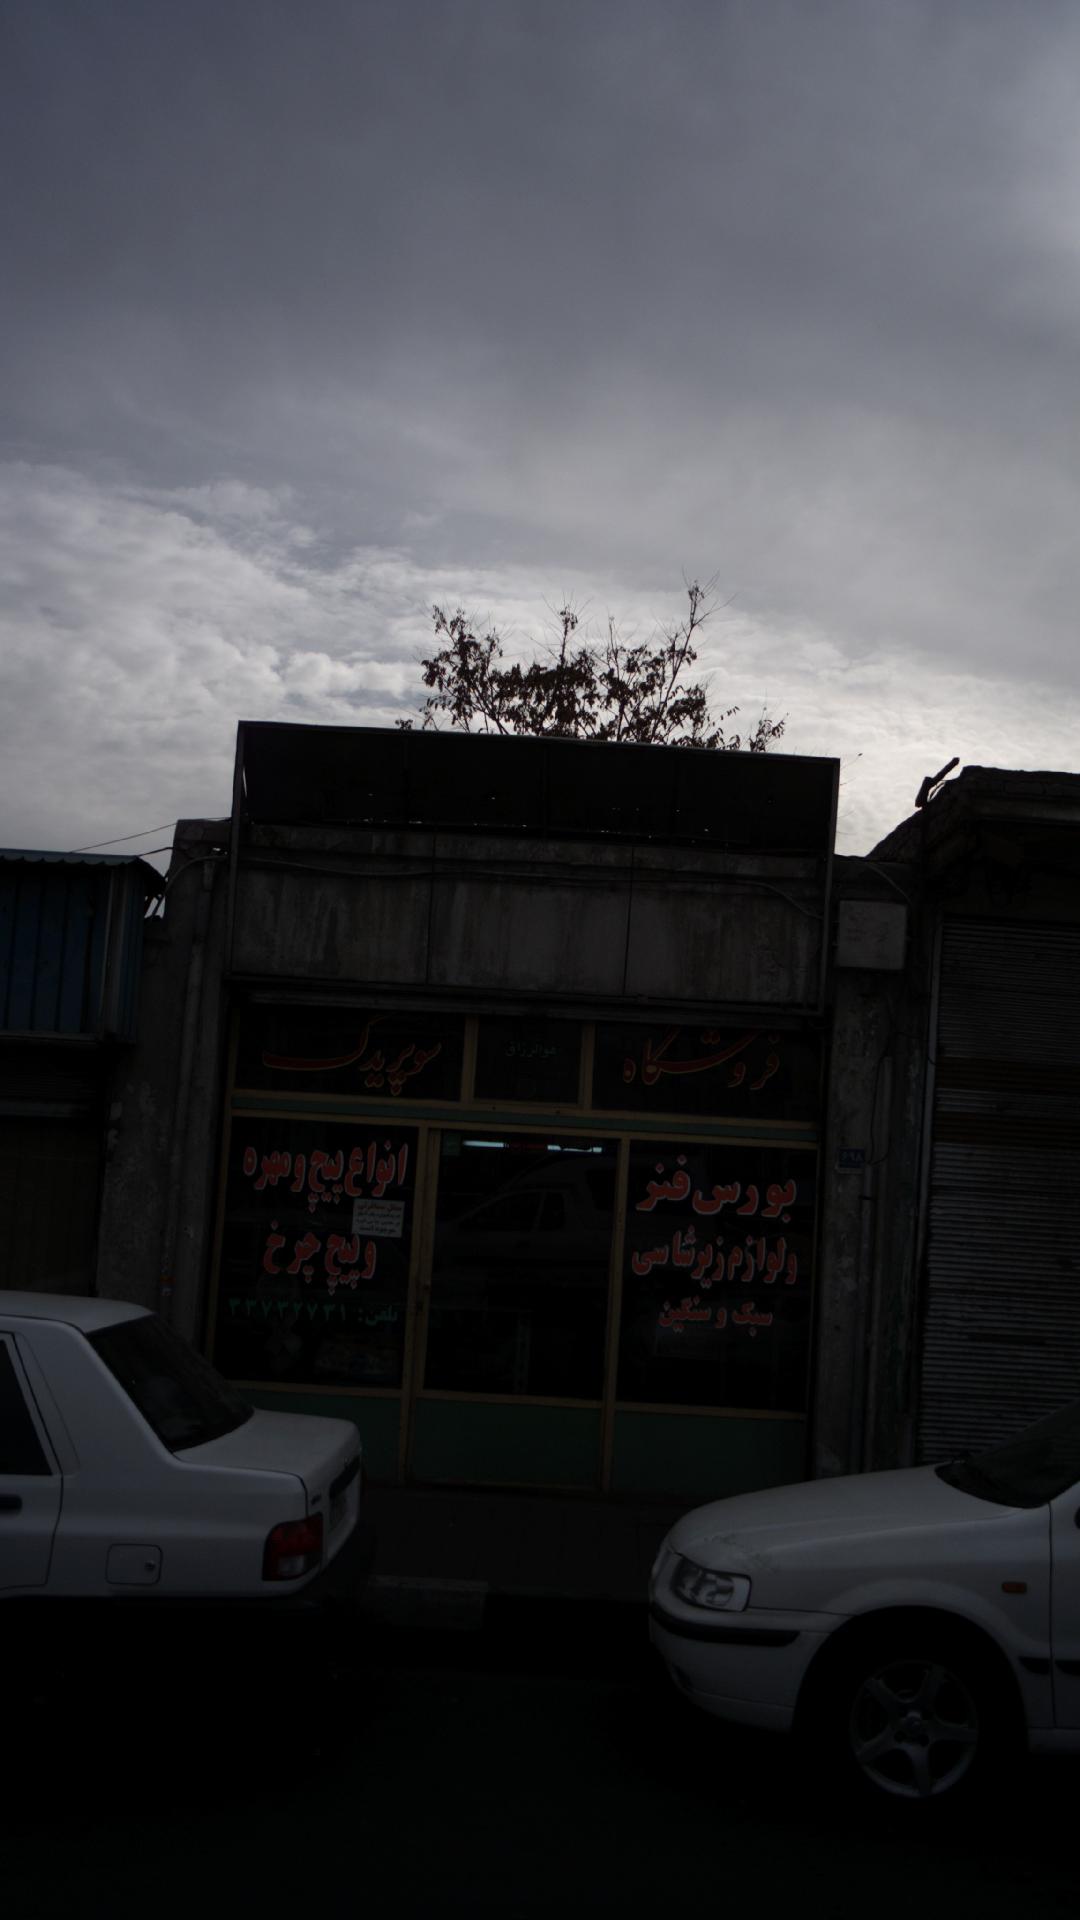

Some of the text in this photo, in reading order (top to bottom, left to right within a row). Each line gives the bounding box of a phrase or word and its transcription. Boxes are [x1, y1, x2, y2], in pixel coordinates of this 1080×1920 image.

[242, 1145, 291, 1191] مهره
[307, 1149, 344, 1214] پیچ
[344, 1140, 409, 1198] انواع
[635, 1154, 798, 1225] بورس فنر
[263, 1219, 322, 1285] چرخ
[657, 1294, 711, 1333] سنگین
[731, 1300, 775, 1338] سبک
